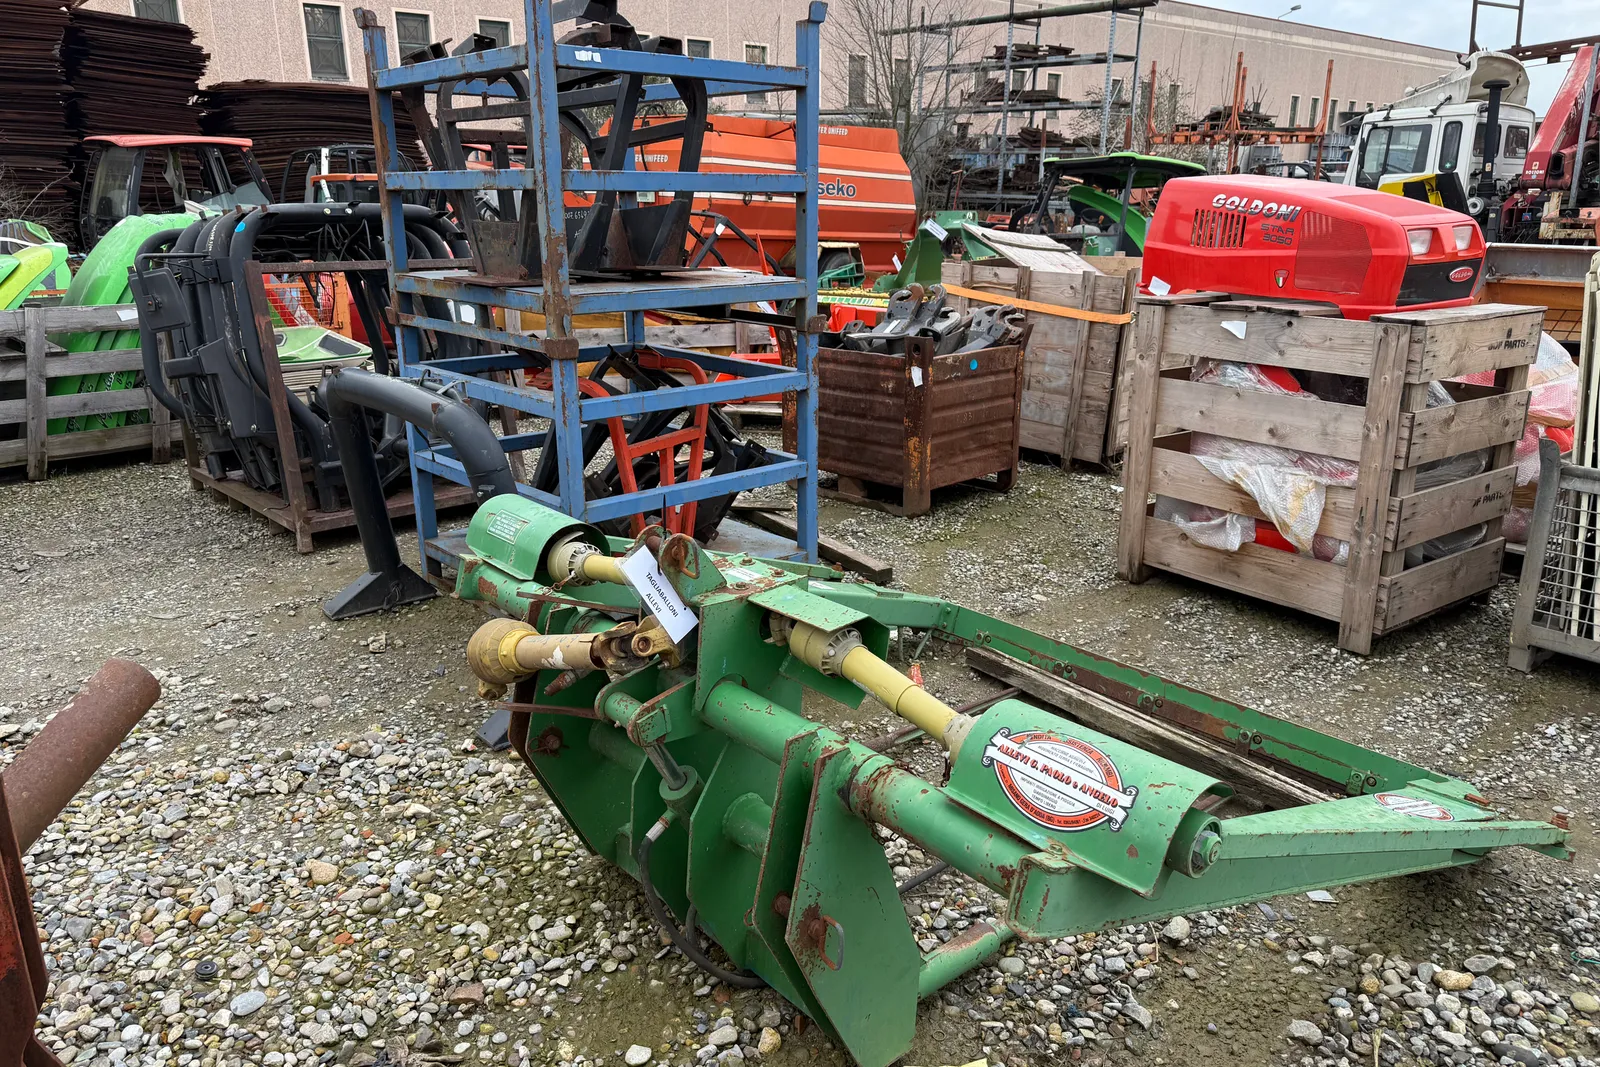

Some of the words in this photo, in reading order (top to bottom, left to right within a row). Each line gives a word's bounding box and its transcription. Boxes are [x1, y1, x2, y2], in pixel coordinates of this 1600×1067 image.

[818, 178, 857, 198] seko
[1212, 193, 1302, 222] GOLDONI
[1261, 223, 1294, 235] STAR
[1263, 233, 1293, 246] 3050
[1504, 339, 1526, 350] PARTS
[645, 572, 679, 618] TAGLIABALLONI
[645, 592, 662, 614] ALLEVI
[997, 743, 1031, 765] ALLEVI
[1040, 763, 1072, 785] PAOLO
[1079, 783, 1118, 808] ANGELO
